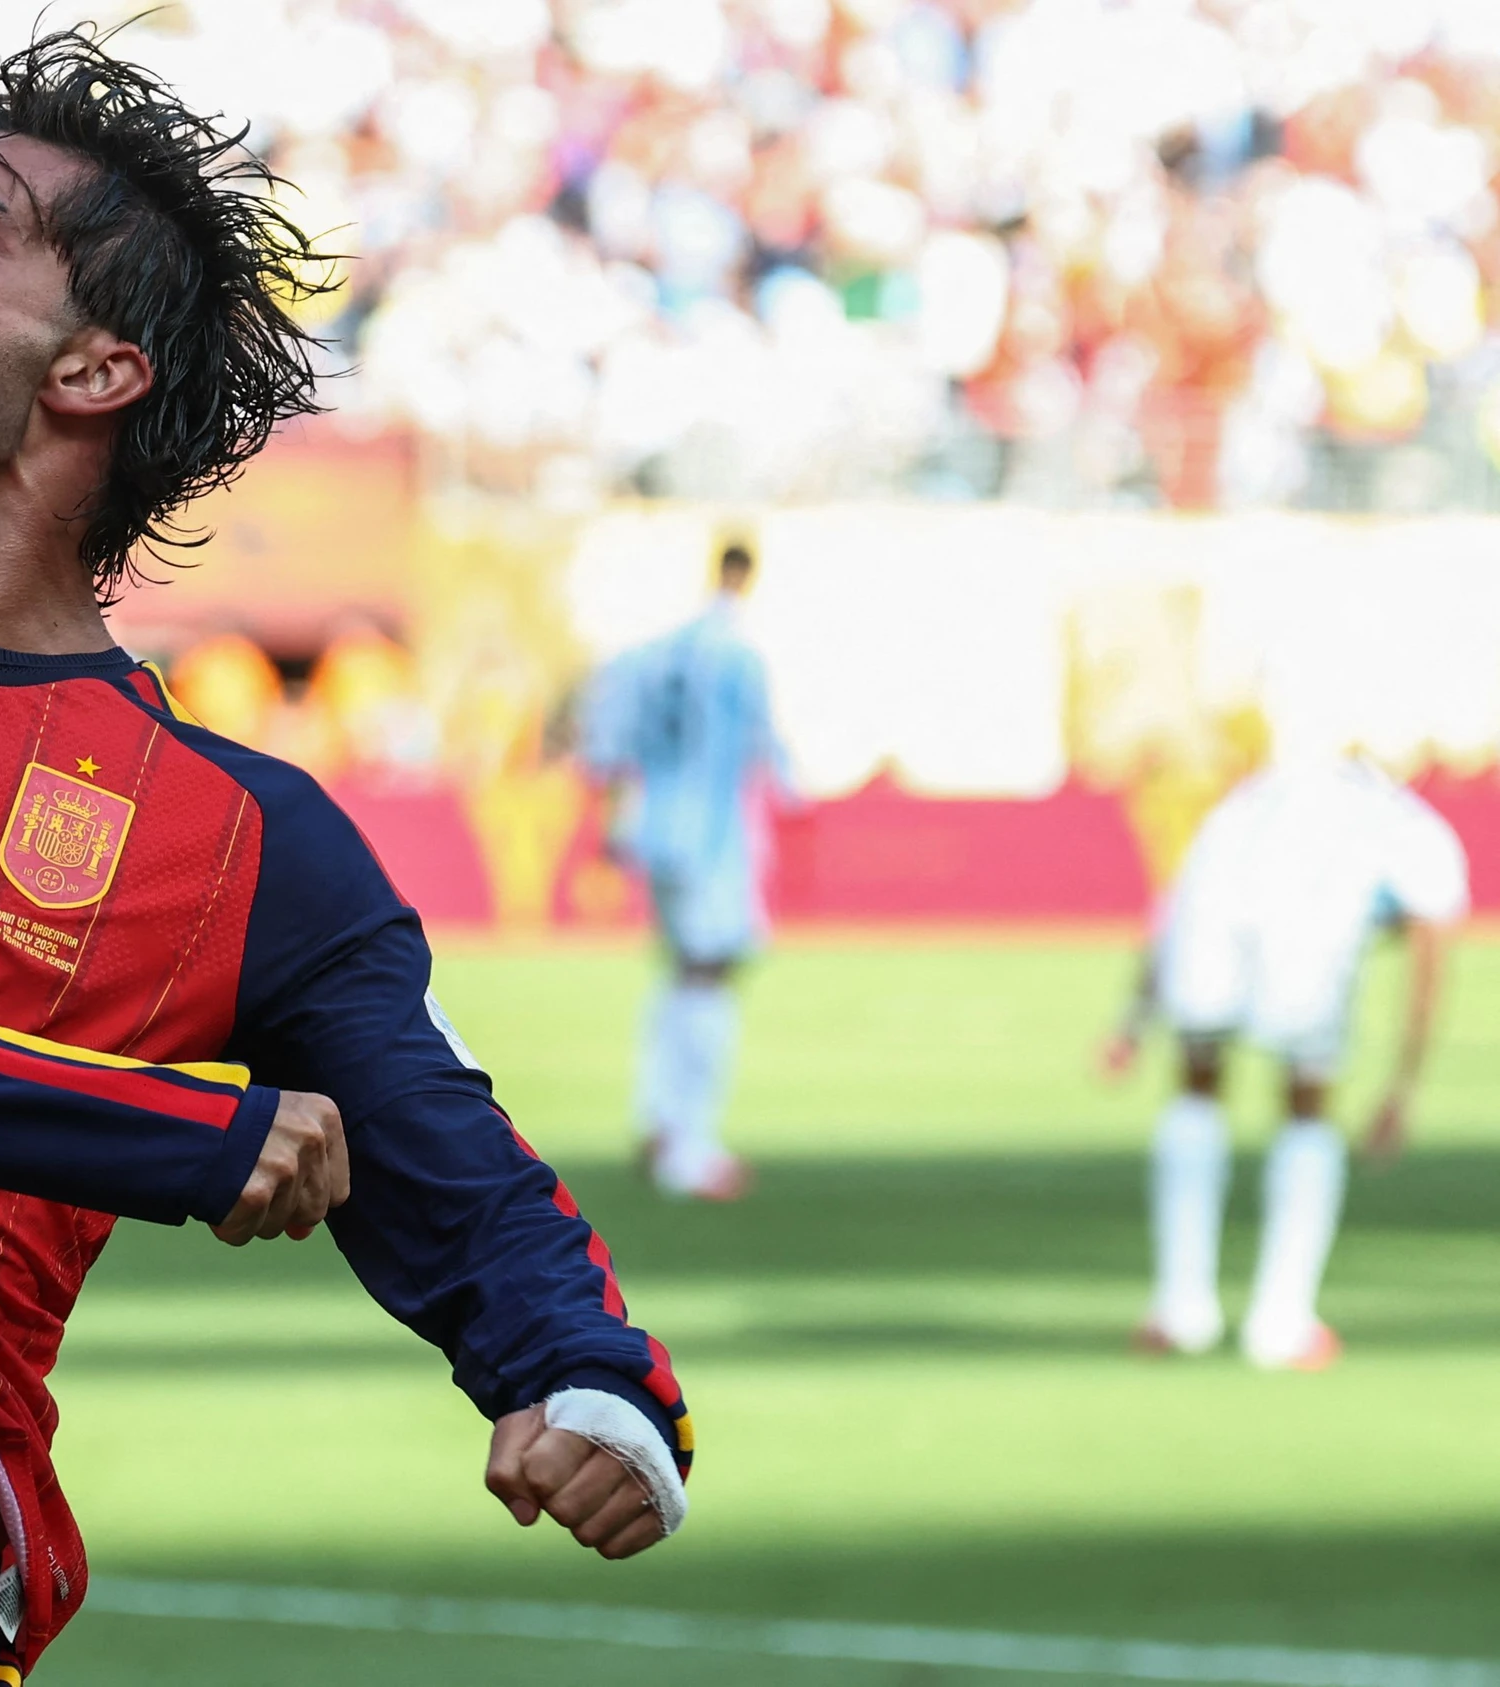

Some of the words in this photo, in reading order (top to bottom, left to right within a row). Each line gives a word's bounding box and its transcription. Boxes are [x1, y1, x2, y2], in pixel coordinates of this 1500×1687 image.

[13, 929, 34, 945] JULY
[33, 937, 59, 955] 2026
[30, 922, 79, 949] ARGENTINA
[24, 944, 44, 960] NEW
[45, 954, 76, 974] JERSEY
